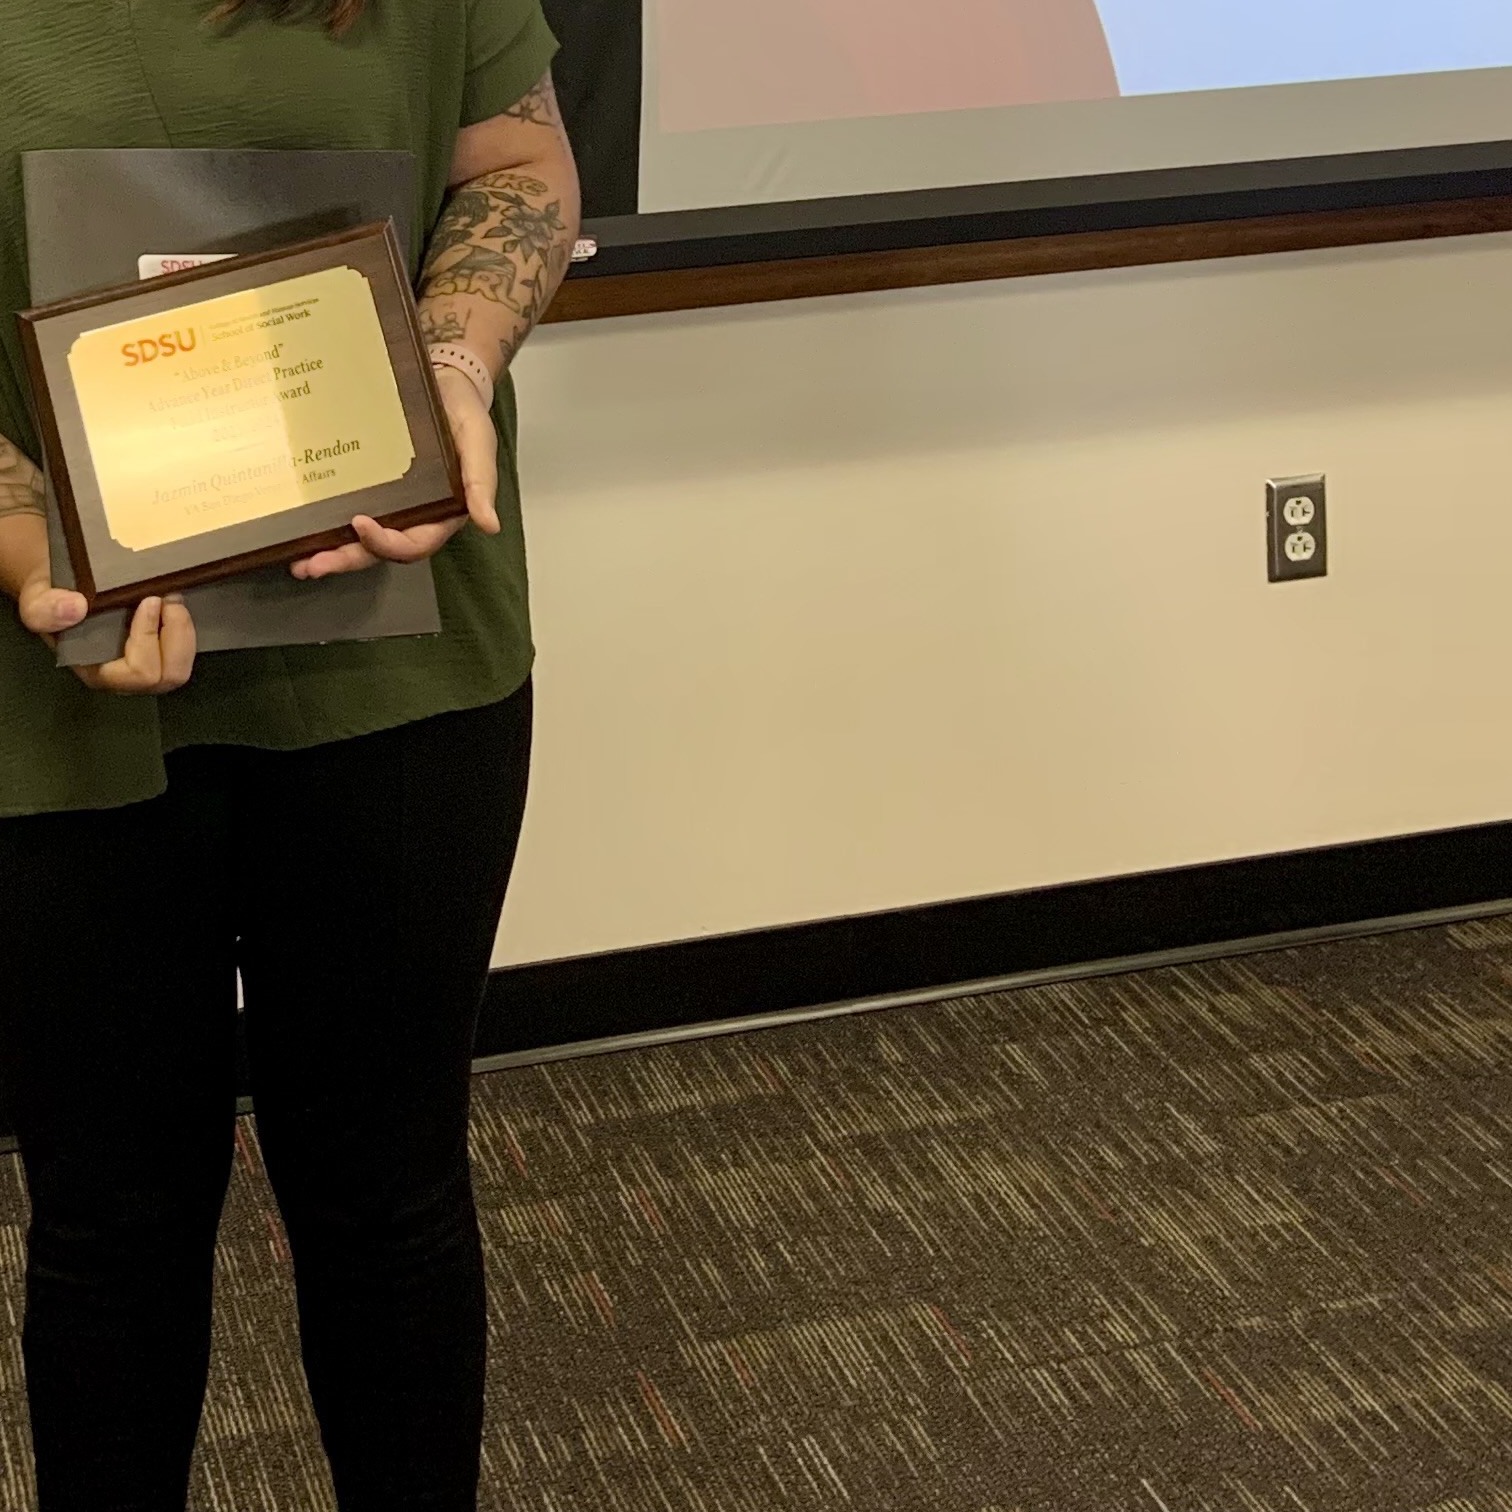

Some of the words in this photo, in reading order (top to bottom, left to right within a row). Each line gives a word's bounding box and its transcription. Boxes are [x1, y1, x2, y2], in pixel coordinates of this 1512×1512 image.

[285, 308, 312, 323] Work
[121, 327, 197, 367] SDSU
[273, 357, 324, 381] Practice
